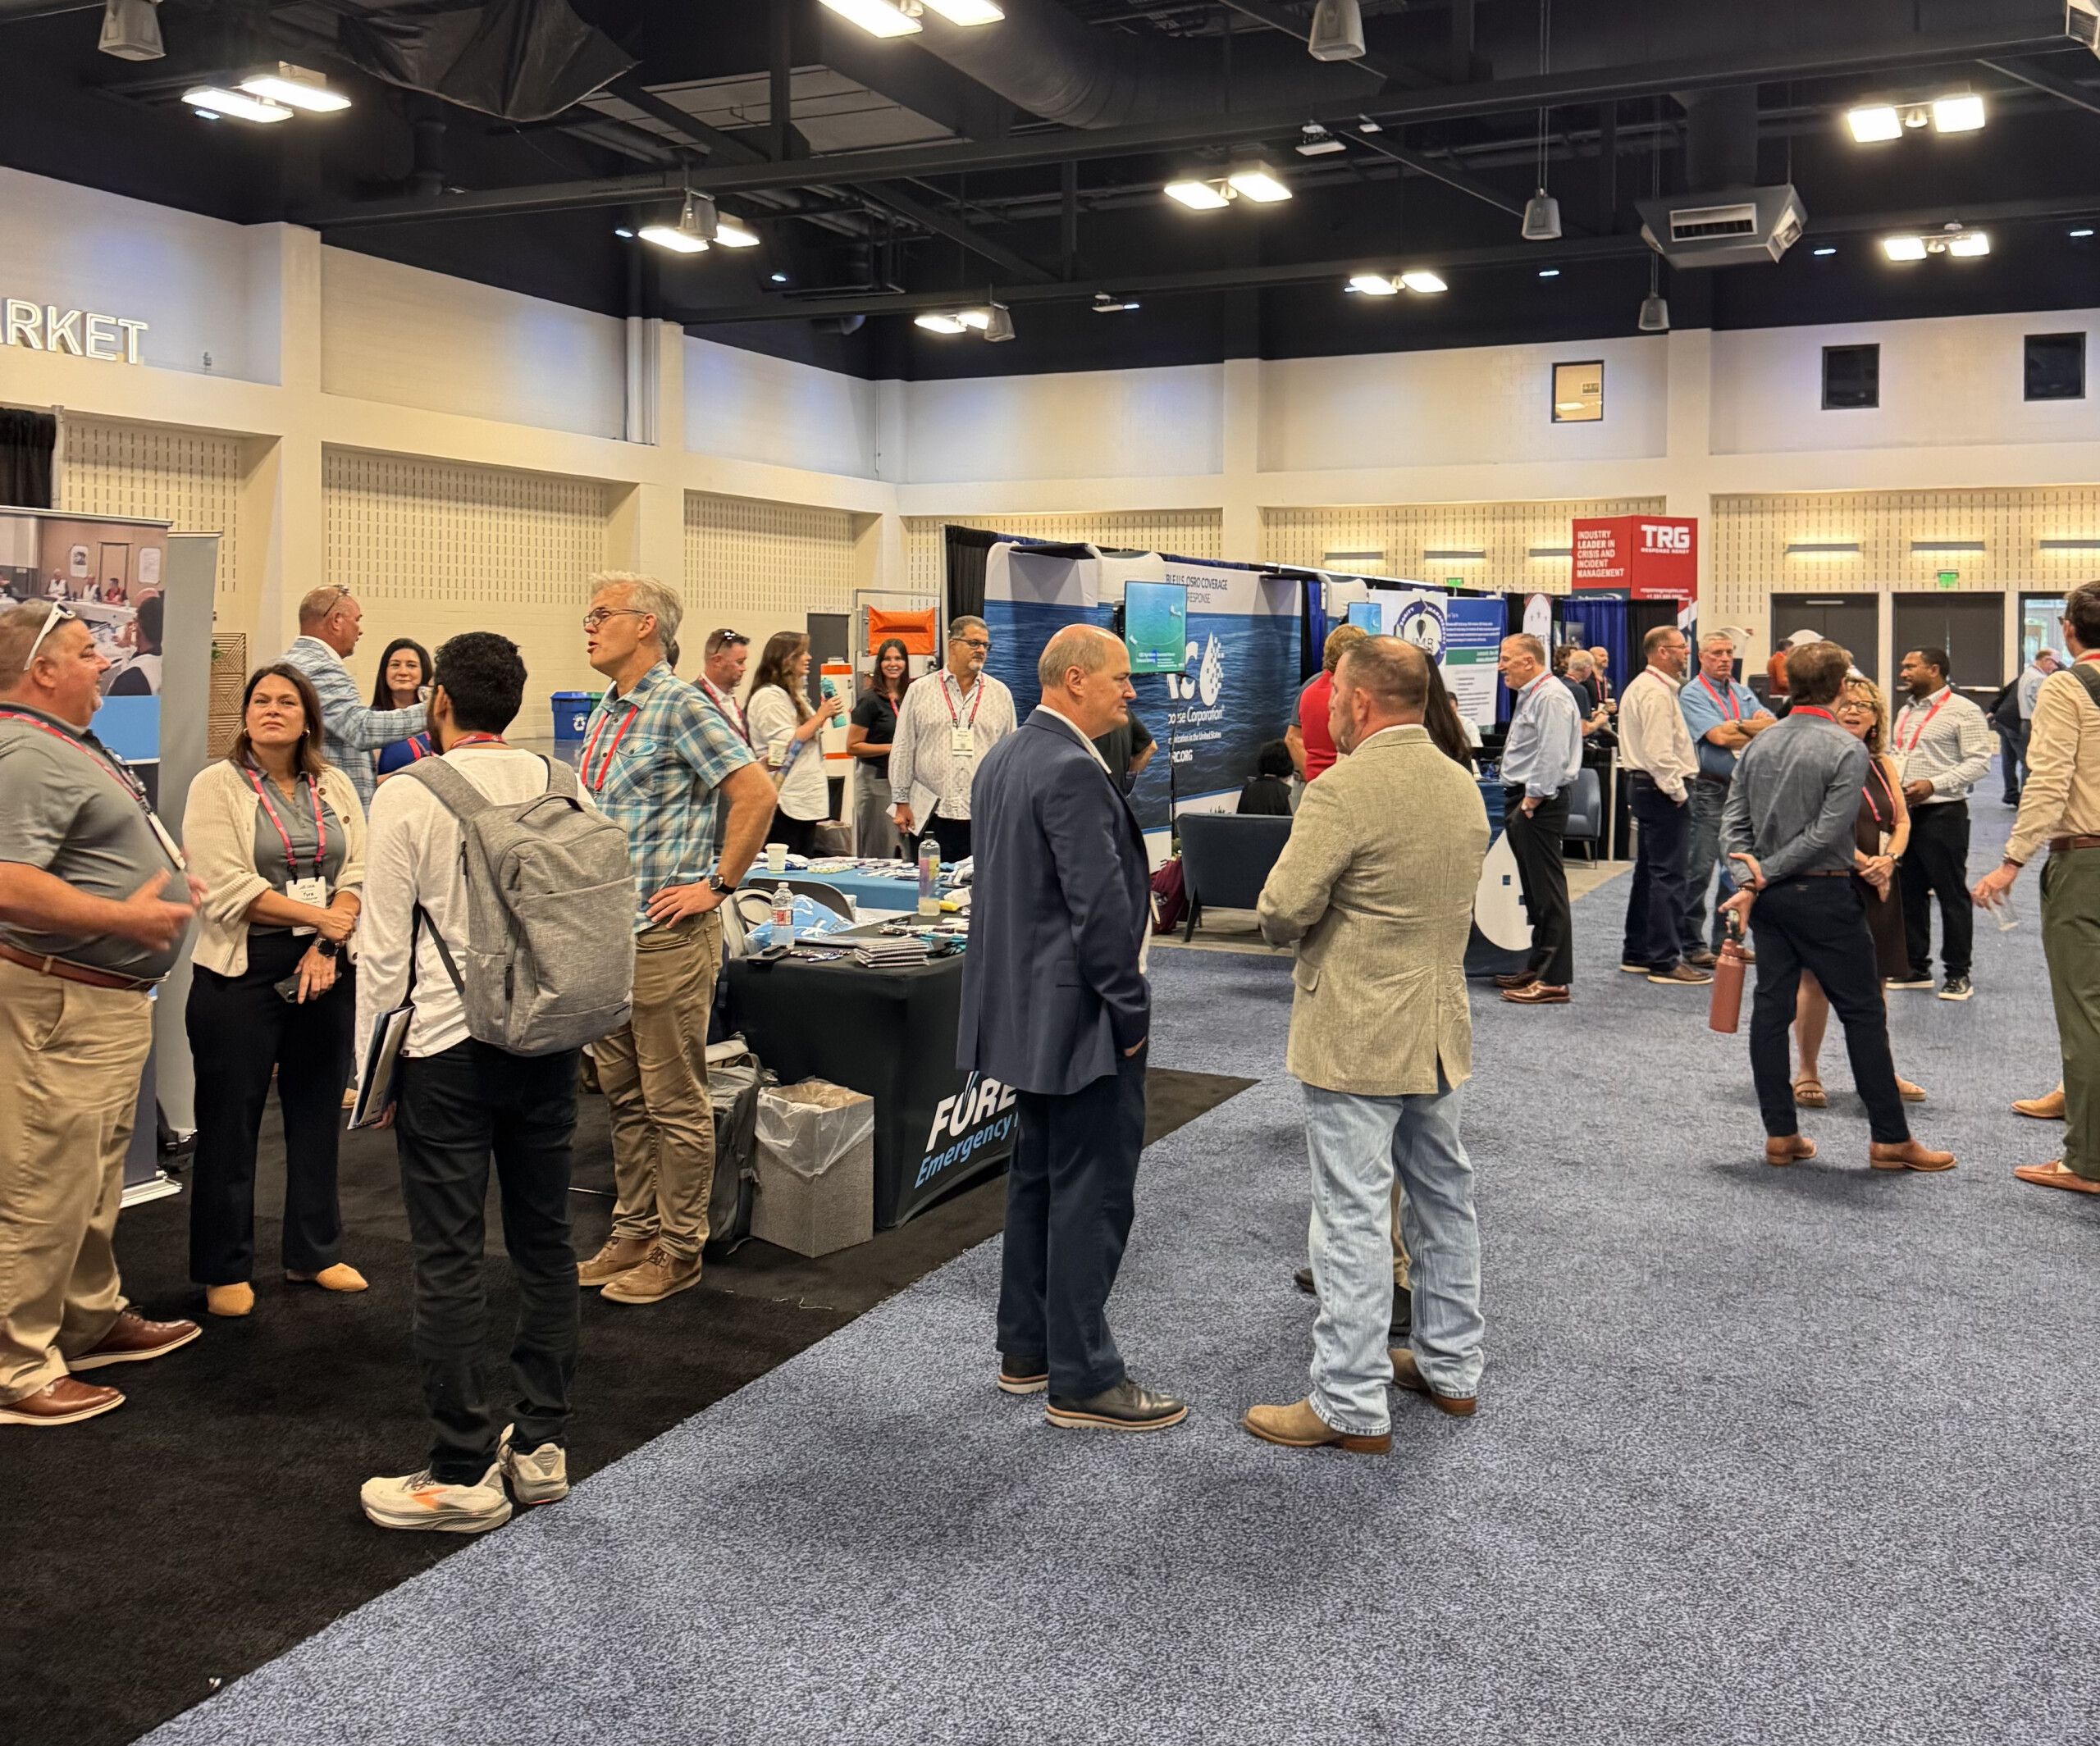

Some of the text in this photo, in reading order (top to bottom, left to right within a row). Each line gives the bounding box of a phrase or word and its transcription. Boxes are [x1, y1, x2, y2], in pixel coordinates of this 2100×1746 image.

[0, 299, 148, 364] RKET
[1577, 530, 1612, 540] INDUSTRY
[1641, 524, 1690, 548] TRG
[1577, 540, 1615, 549] LEADER IN
[1577, 549, 1615, 558] CRISIS AND
[1577, 558, 1609, 568] INCIDENT
[1577, 568, 1624, 578] MANAGEMENT
[1202, 577, 1228, 590] COVERAGE
[1187, 705, 1223, 727] Corporation
[915, 1114, 1013, 1189] Emergency
